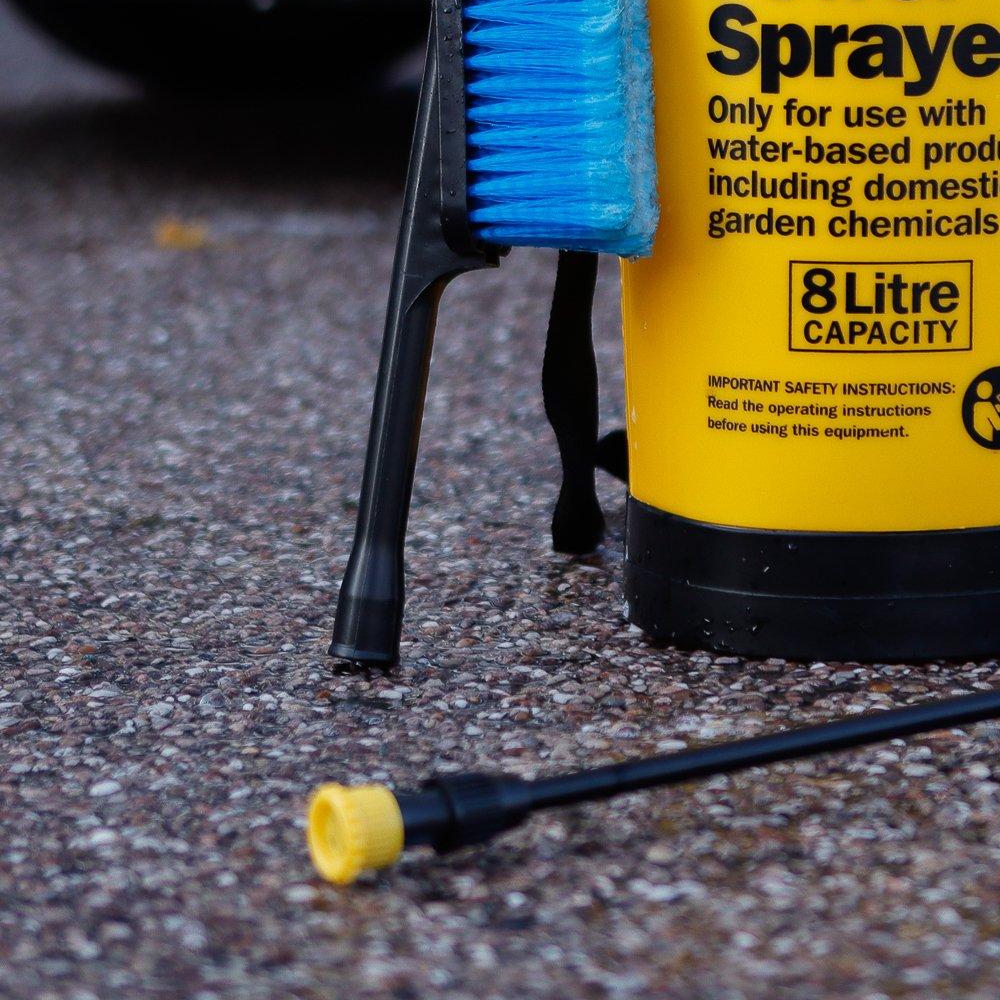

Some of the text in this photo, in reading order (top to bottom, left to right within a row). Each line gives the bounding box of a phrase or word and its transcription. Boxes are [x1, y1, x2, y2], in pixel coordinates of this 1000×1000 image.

[708, 95, 985, 132] Only for use with
[708, 135, 910, 164] water-based
[709, 168, 852, 207] including
[708, 208, 999, 239] garden chemicals
[802, 268, 959, 314] 8 Litre
[804, 320, 958, 345] CAPACITY
[708, 375, 956, 396] IMPORTANT SAFETY INSTRUCTIONS:
[707, 395, 932, 420] Read the operating instructions
[707, 416, 909, 441] before using this equipment.
